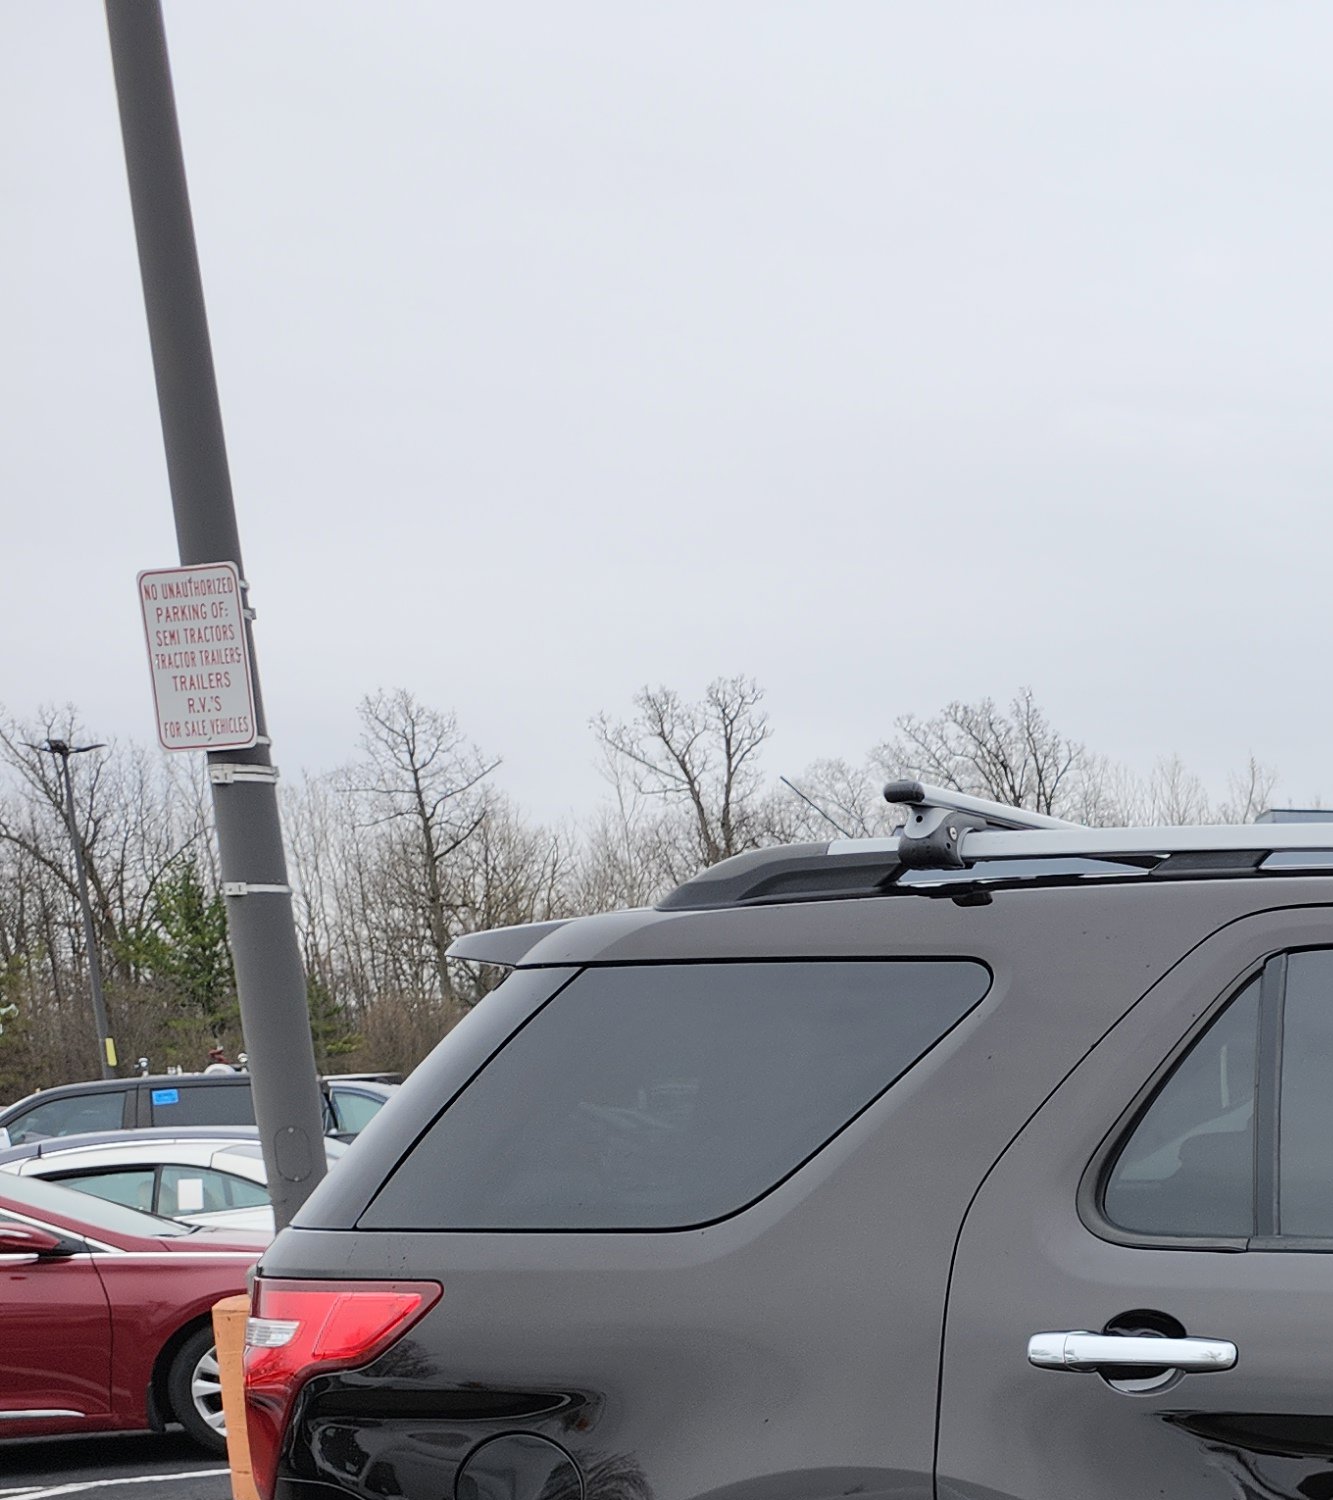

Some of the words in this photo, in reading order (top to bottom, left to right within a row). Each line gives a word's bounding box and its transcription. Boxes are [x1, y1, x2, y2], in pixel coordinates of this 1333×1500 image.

[144, 583, 158, 601] NO
[161, 577, 234, 599] UNAUTHORIZED
[156, 603, 207, 623] PARKING
[211, 601, 229, 618] OF:
[156, 629, 180, 647] SEMI
[184, 624, 235, 645] TRACTORS
[155, 651, 197, 670] TRACTOR
[199, 647, 242, 667] TRAILERS
[172, 671, 231, 692] TRAILERS
[188, 695, 222, 714] R.V.'S
[164, 720, 182, 739] FOR
[185, 719, 206, 737] SALE
[210, 716, 249, 735] VEHICLES
